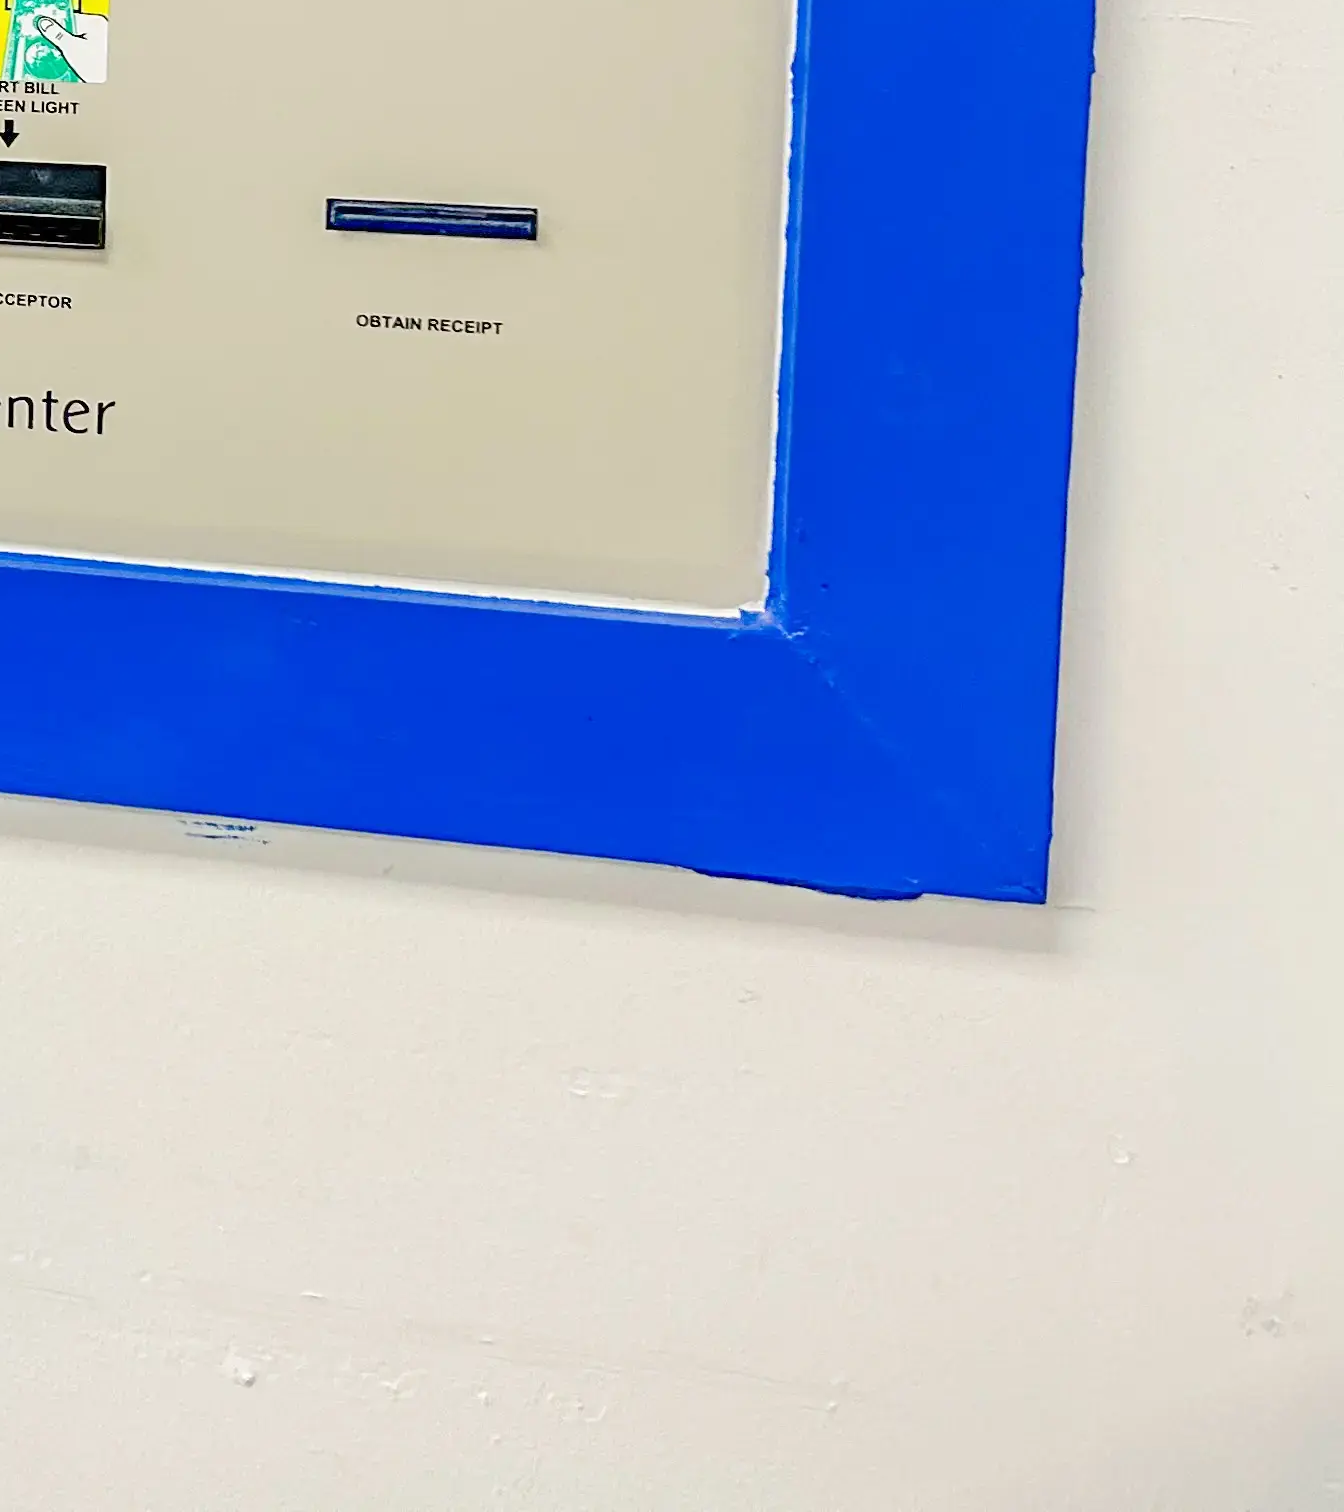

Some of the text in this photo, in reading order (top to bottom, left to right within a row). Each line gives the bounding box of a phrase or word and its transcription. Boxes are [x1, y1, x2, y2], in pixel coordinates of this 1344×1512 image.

[24, 81, 60, 95] BILL
[31, 101, 80, 114] LIGHT
[356, 314, 503, 334] OBTAIN RECEIPT
